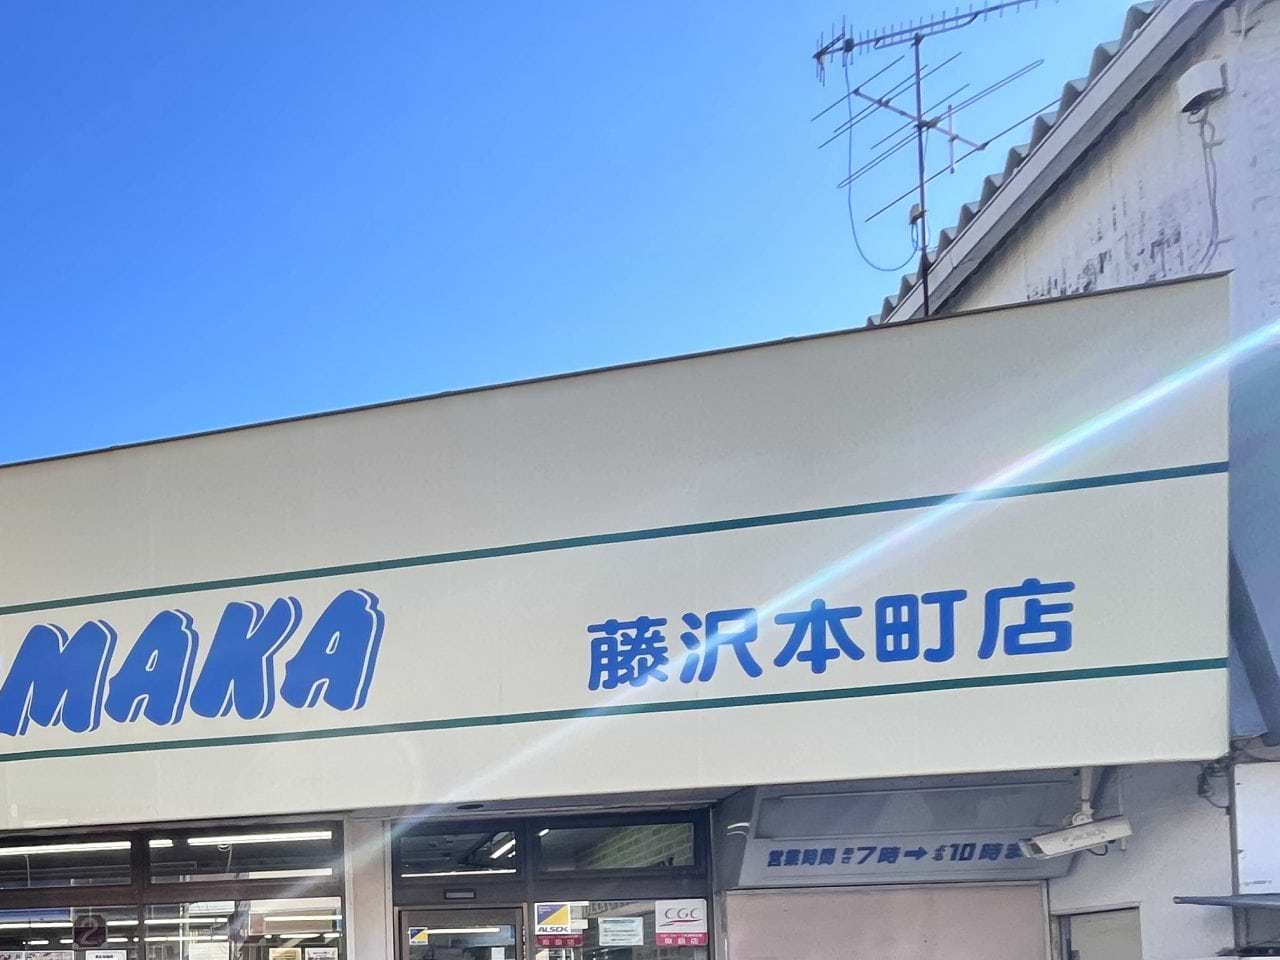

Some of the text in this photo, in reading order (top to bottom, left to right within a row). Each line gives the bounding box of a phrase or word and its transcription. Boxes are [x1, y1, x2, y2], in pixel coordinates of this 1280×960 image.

[588, 576, 1076, 691] 藤沢本町店
[664, 907, 699, 919] CGC
[80, 916, 100, 945] 2
